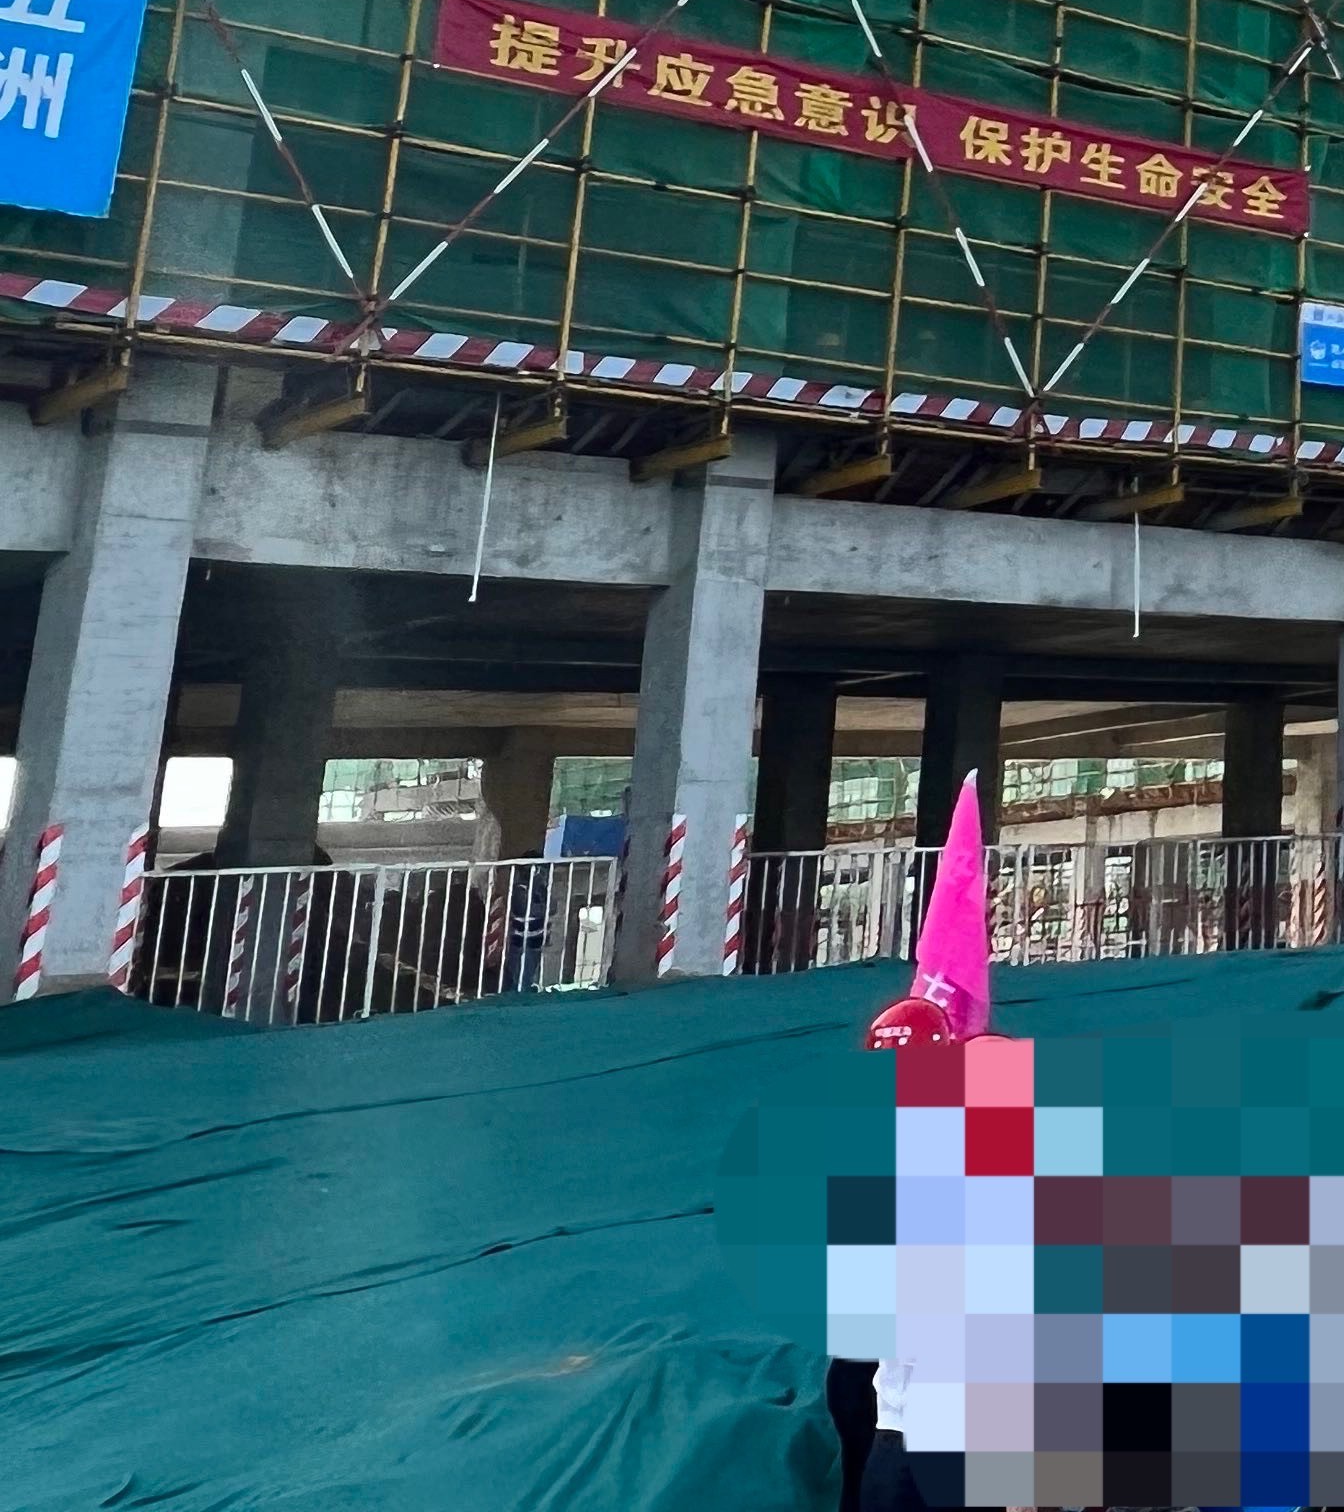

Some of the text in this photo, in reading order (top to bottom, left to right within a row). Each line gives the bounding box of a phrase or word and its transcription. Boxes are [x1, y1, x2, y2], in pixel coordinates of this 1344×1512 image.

[489, 13, 1288, 220] 提升应急意识 保护生命安全
